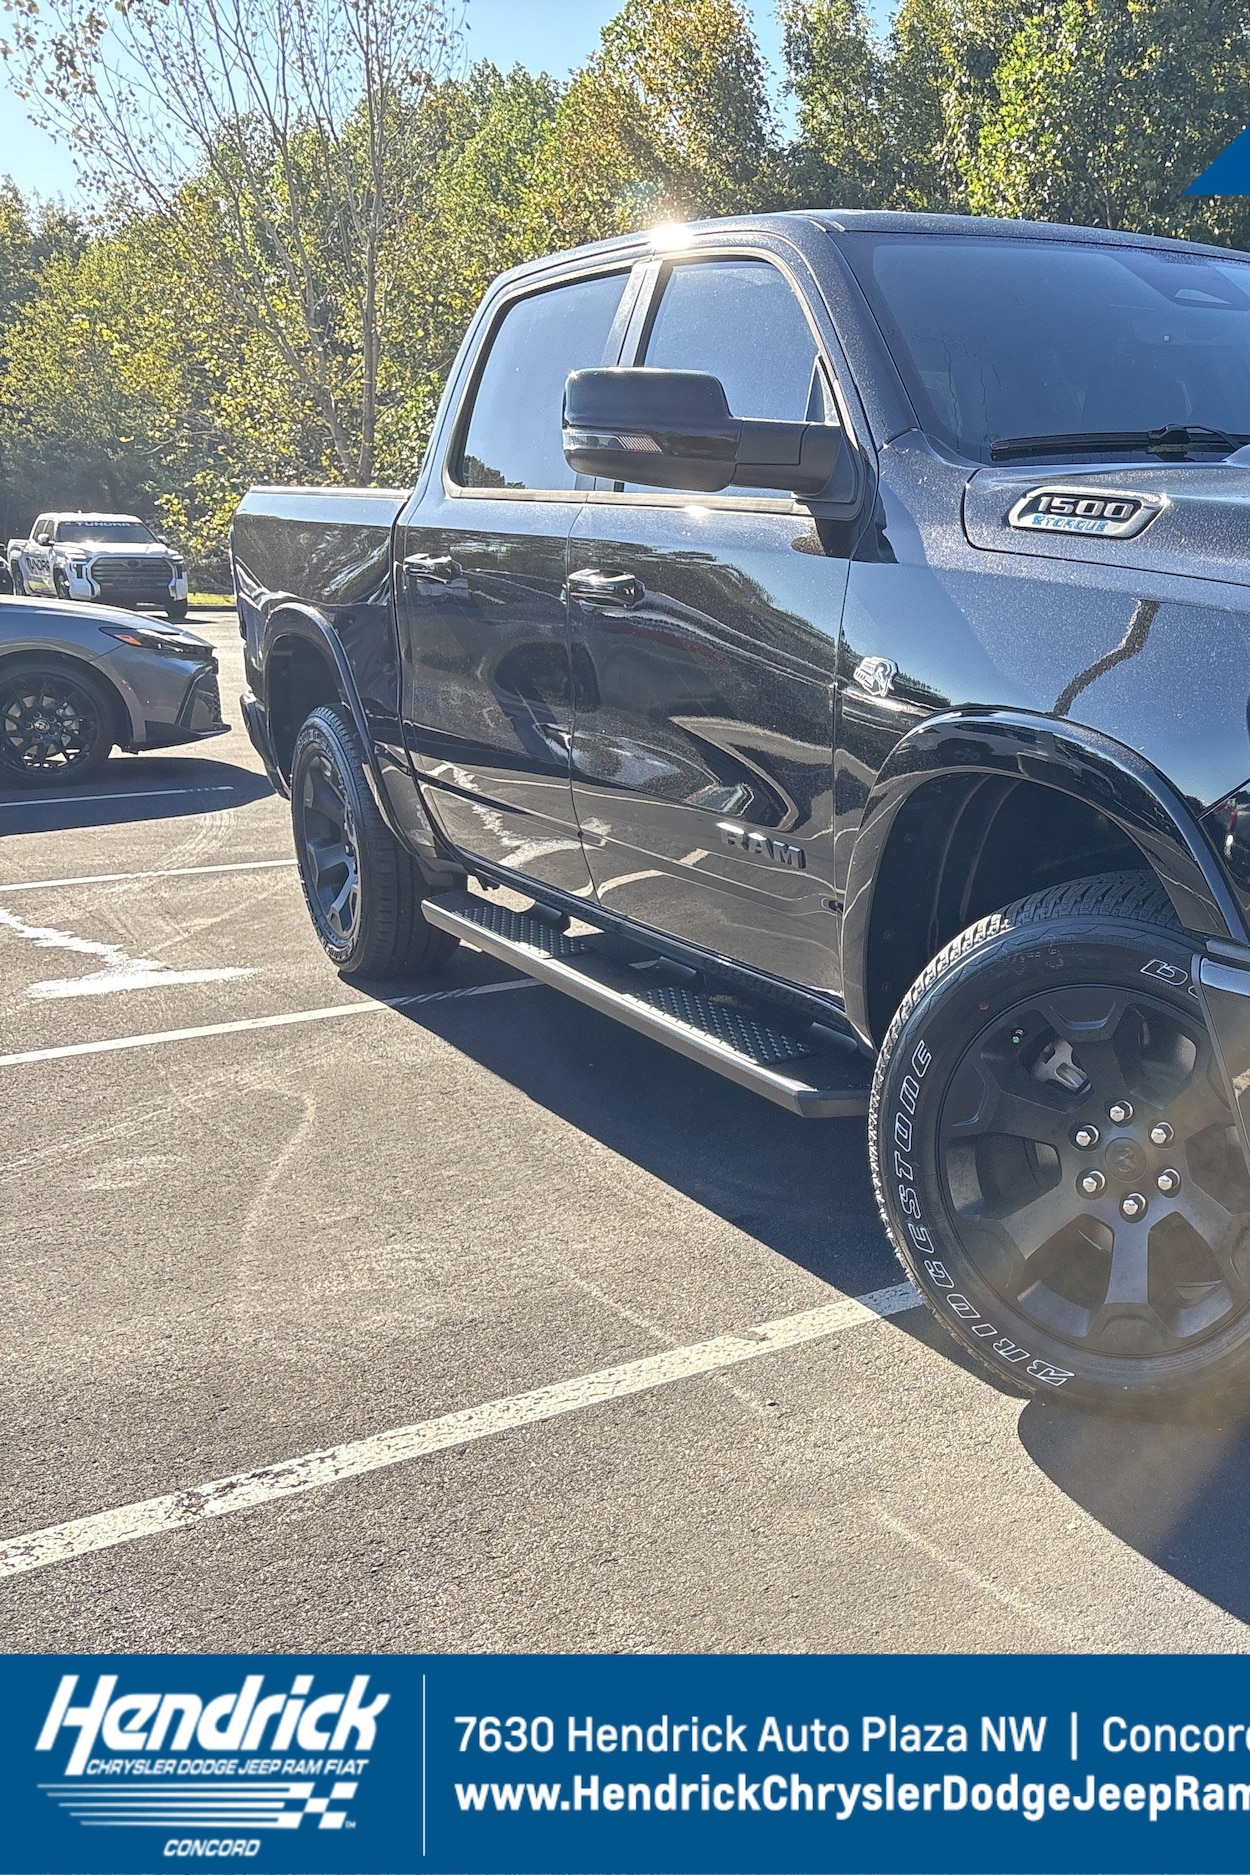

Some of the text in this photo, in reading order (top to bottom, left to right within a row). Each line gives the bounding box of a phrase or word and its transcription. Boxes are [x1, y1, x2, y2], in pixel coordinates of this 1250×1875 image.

[1037, 495, 1134, 519] 1500
[716, 822, 807, 870] RAM
[894, 1039, 1075, 1387] BRIDGESTONE
